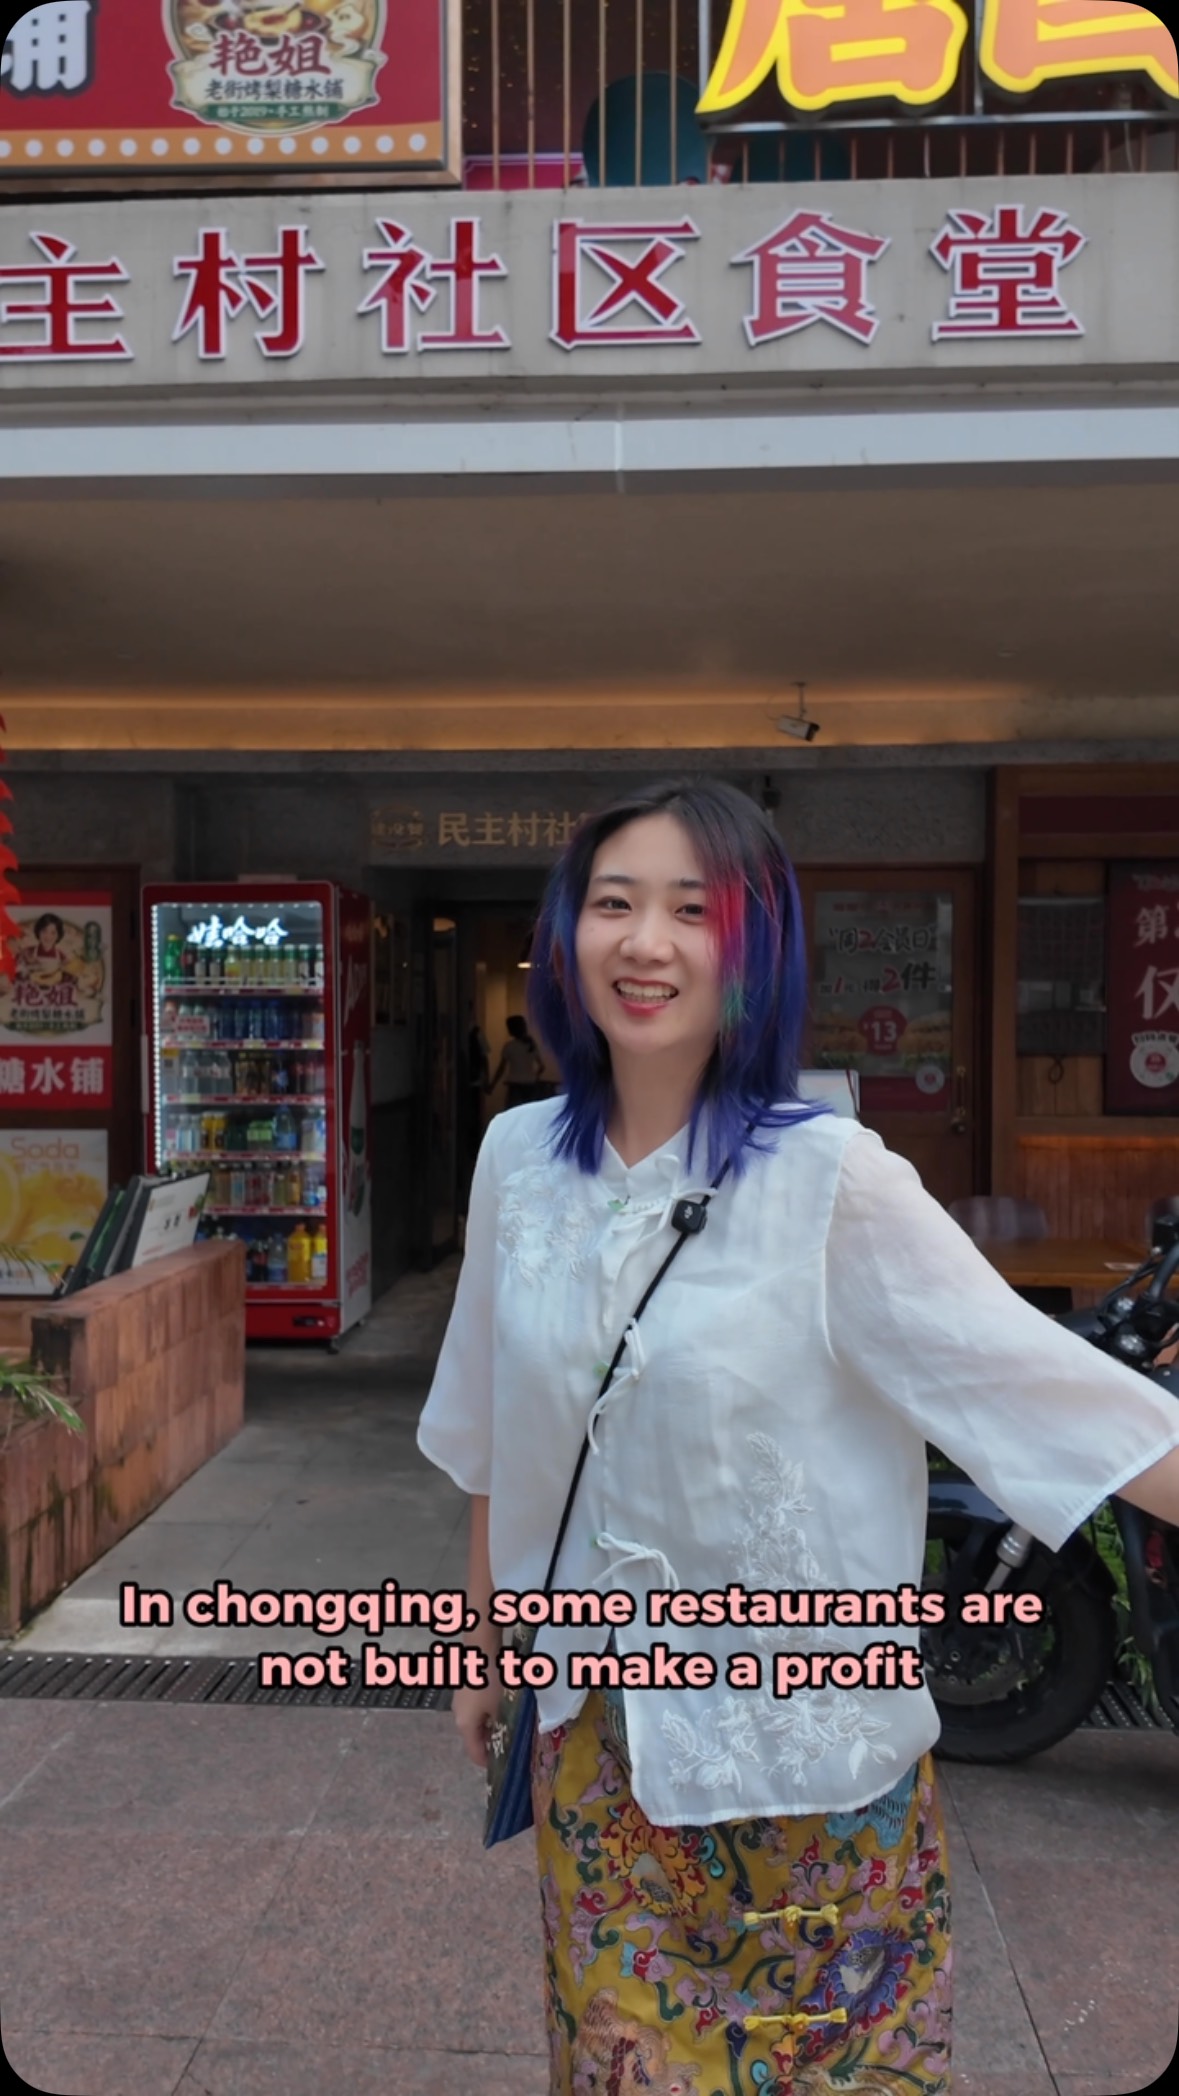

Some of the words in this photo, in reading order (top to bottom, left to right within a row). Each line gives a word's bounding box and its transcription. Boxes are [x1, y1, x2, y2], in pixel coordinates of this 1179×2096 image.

[209, 32, 332, 77] 艳姐
[0, 204, 1087, 363] 主村社区食堂
[187, 914, 289, 948] 娃哈哈
[0, 1056, 104, 1096] 糖水铺
[10, 1135, 80, 1160] Soda
